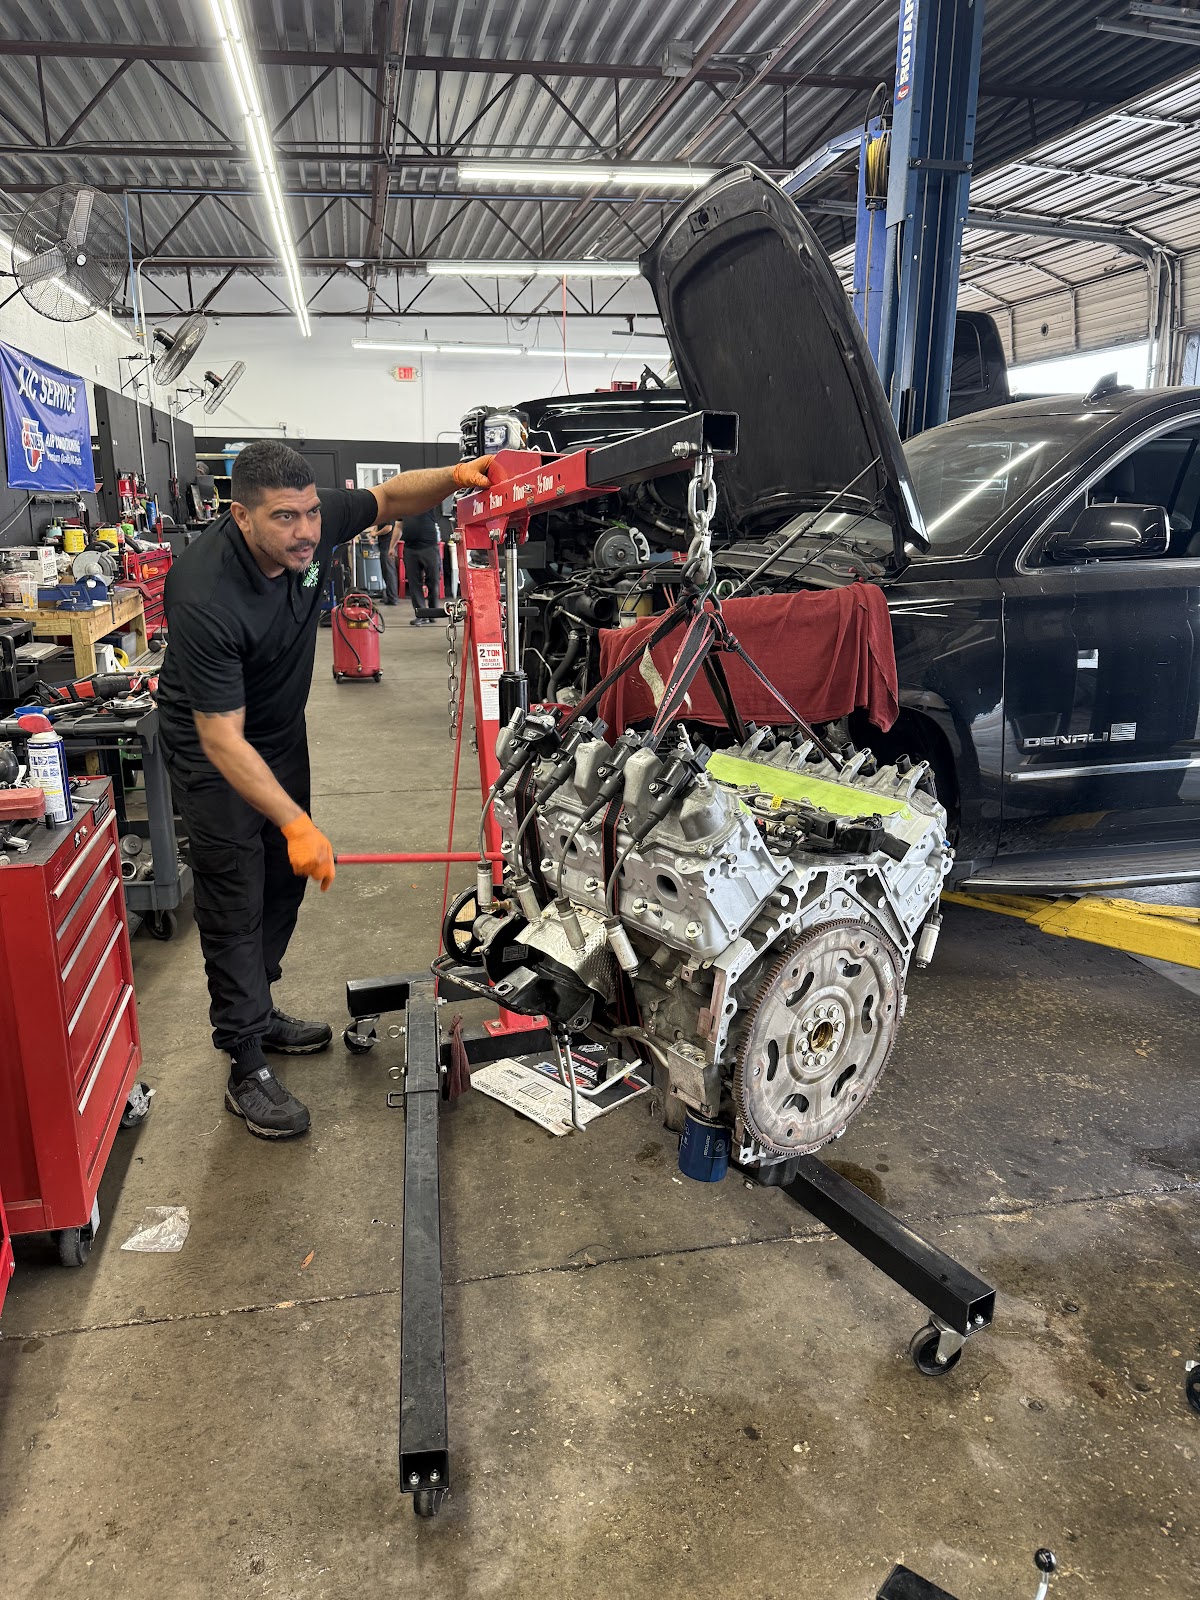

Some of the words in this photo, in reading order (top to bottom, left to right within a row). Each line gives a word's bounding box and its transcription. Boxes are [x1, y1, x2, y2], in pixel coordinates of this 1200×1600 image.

[399, 367, 413, 380] EXIT
[40, 375, 76, 414] SERVICE
[480, 649, 486, 658] 2
[1023, 732, 1109, 748] DENALI
